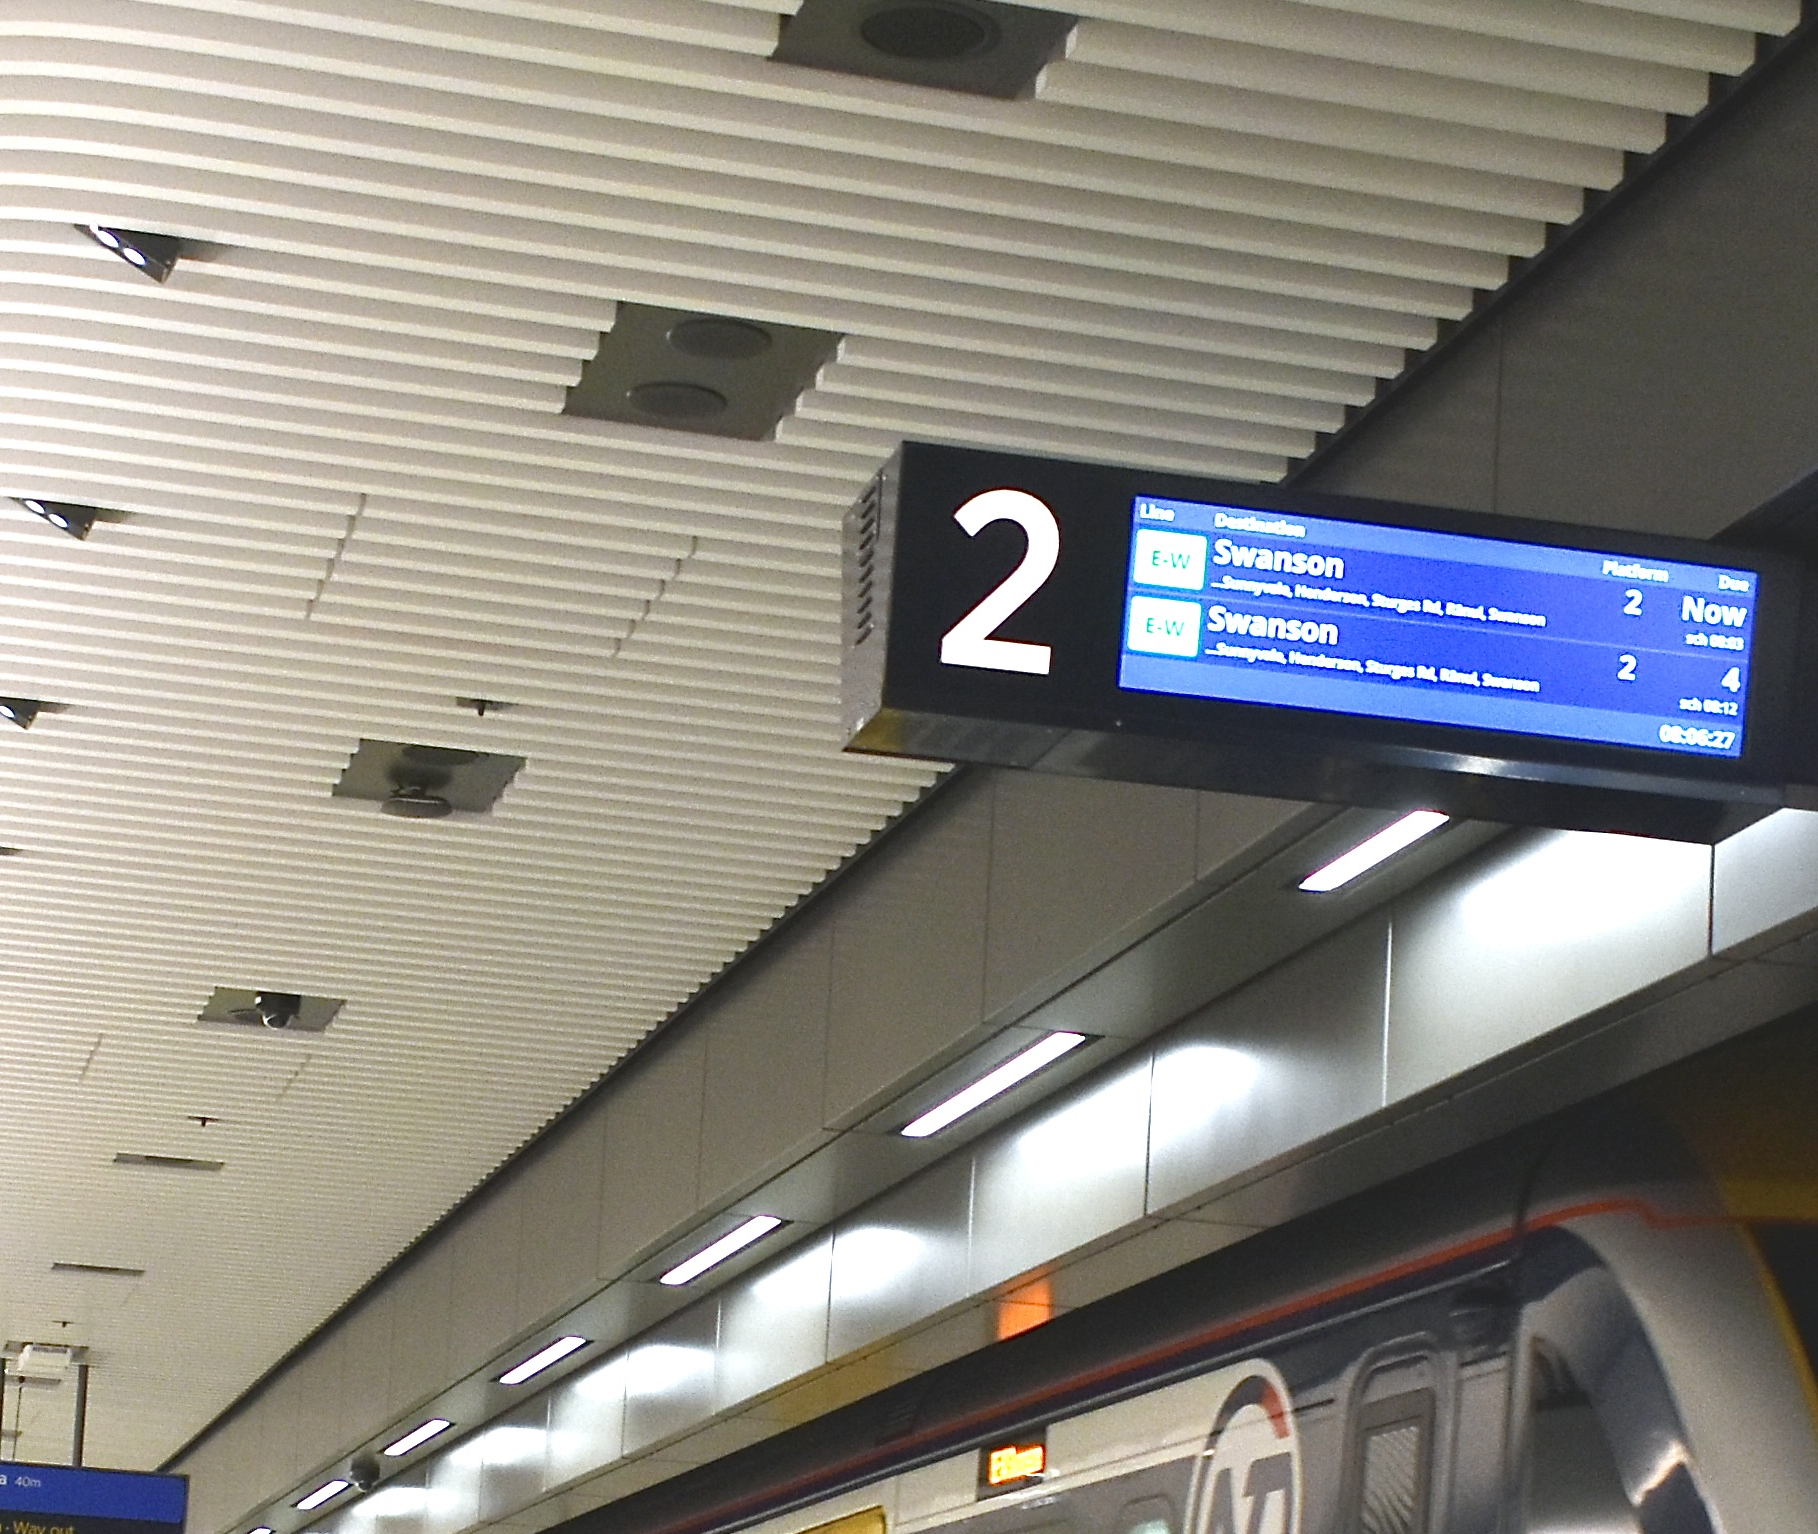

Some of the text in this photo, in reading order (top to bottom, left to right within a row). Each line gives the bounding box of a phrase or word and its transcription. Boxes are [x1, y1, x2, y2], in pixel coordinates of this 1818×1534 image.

[941, 488, 1060, 675] 2
[1140, 503, 1749, 592] Line Destination Platform Due
[1151, 538, 1747, 627] E-W Swanson 2 Now
[1145, 605, 1741, 693] E-W Swanson 2 4
[1659, 724, 1736, 749] 08:06:27
[14, 1475, 42, 1489] 40m
